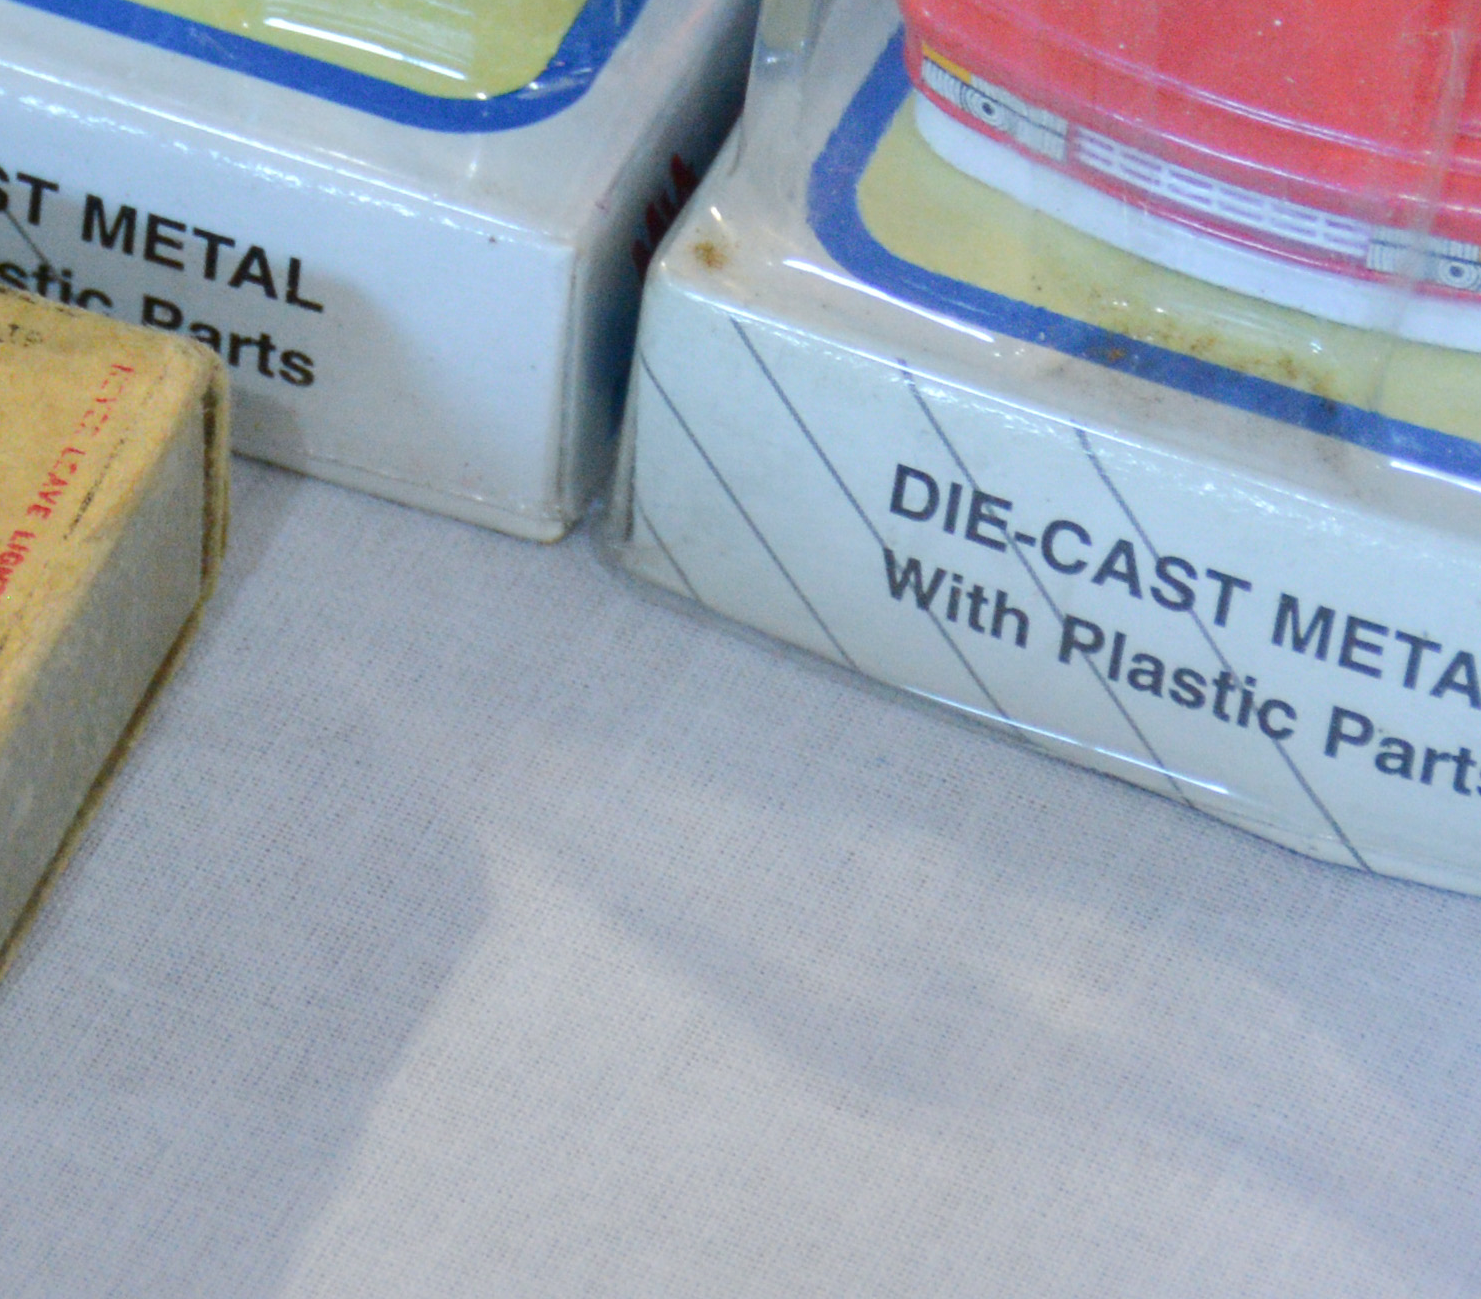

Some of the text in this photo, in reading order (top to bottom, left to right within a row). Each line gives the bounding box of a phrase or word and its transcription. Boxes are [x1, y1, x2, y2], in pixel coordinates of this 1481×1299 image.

[81, 193, 325, 314] METAL
[888, 463, 1252, 627] DIE-CAST
[884, 547, 1030, 648] With
[1057, 614, 1299, 741] Plastic
